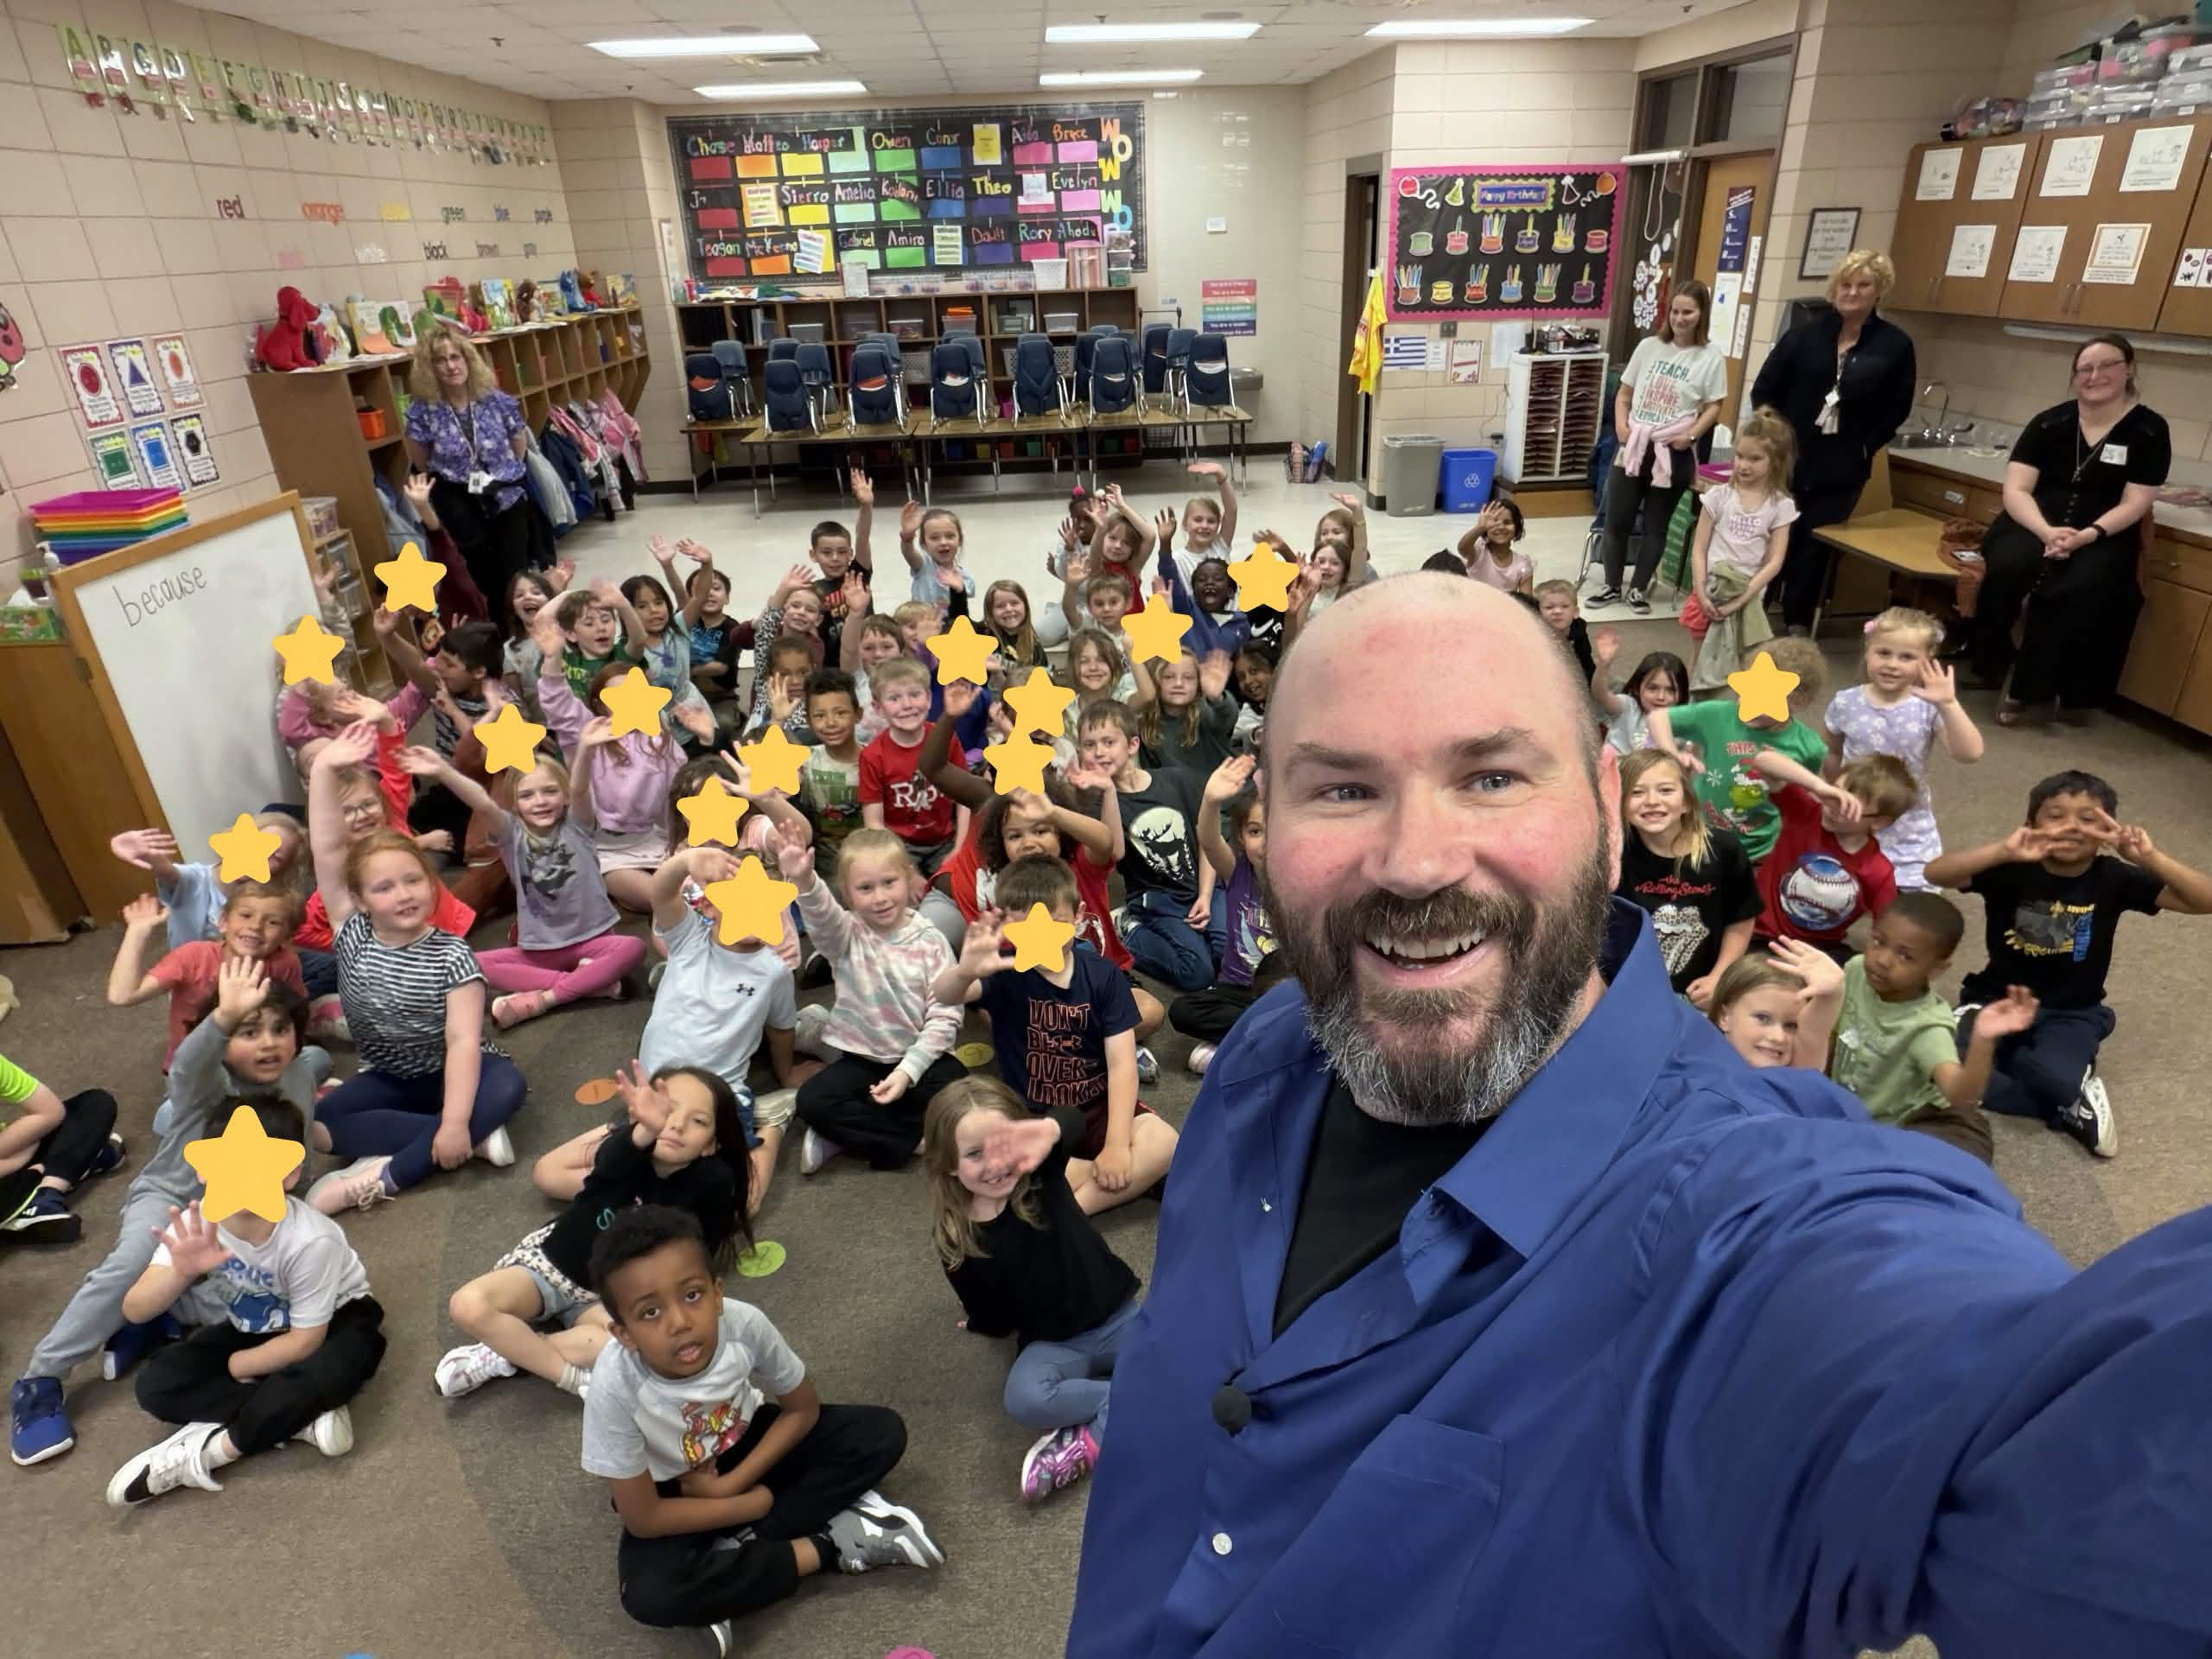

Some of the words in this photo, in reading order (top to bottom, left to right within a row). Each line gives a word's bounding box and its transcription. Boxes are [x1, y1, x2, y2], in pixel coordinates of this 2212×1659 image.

[871, 131, 912, 149] Owen
[1052, 124, 1089, 143] Bryce
[686, 134, 736, 156] Chase
[971, 175, 1013, 195] Theo
[1051, 166, 1098, 191] Evelyn
[780, 185, 830, 204] Sierra
[833, 182, 877, 202] Amelia
[216, 194, 245, 218] red
[696, 238, 741, 257] Teagan
[887, 230, 925, 246] Amira
[1655, 359, 1690, 382] TEACH.
[111, 566, 207, 627] because
[1635, 880, 1679, 900] Rolling
[1027, 995, 1091, 1032] DON'T
